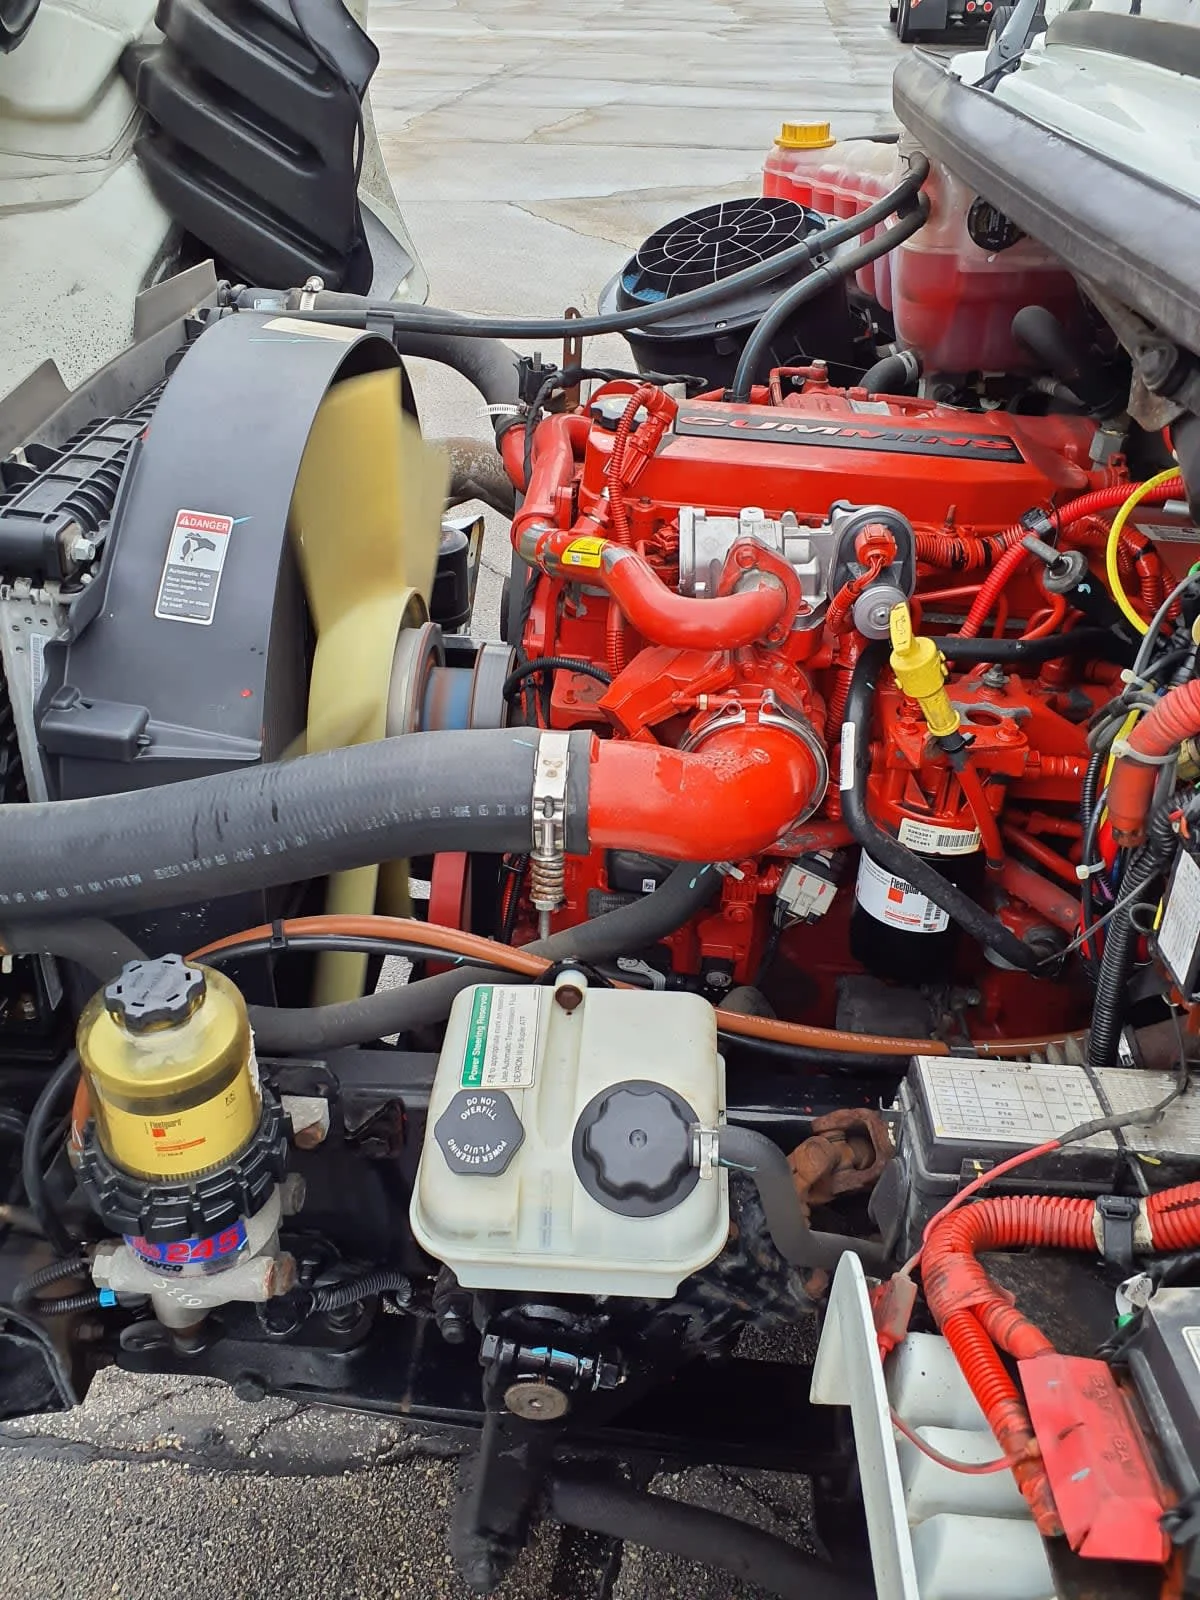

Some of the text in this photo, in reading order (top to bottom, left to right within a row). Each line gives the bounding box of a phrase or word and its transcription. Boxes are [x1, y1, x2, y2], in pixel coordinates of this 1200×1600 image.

[679, 416, 1013, 450] CUMMINS
[189, 518, 229, 531] DANGER
[468, 991, 489, 1081] Power Steering Reservoir
[466, 1096, 497, 1107] DO NOT
[460, 1105, 498, 1121] OVERFILL
[447, 1138, 508, 1164] POWER STEERING
[463, 1143, 491, 1154] FLUID
[165, 1227, 239, 1263] 245
[139, 1255, 184, 1273] DAVCO
